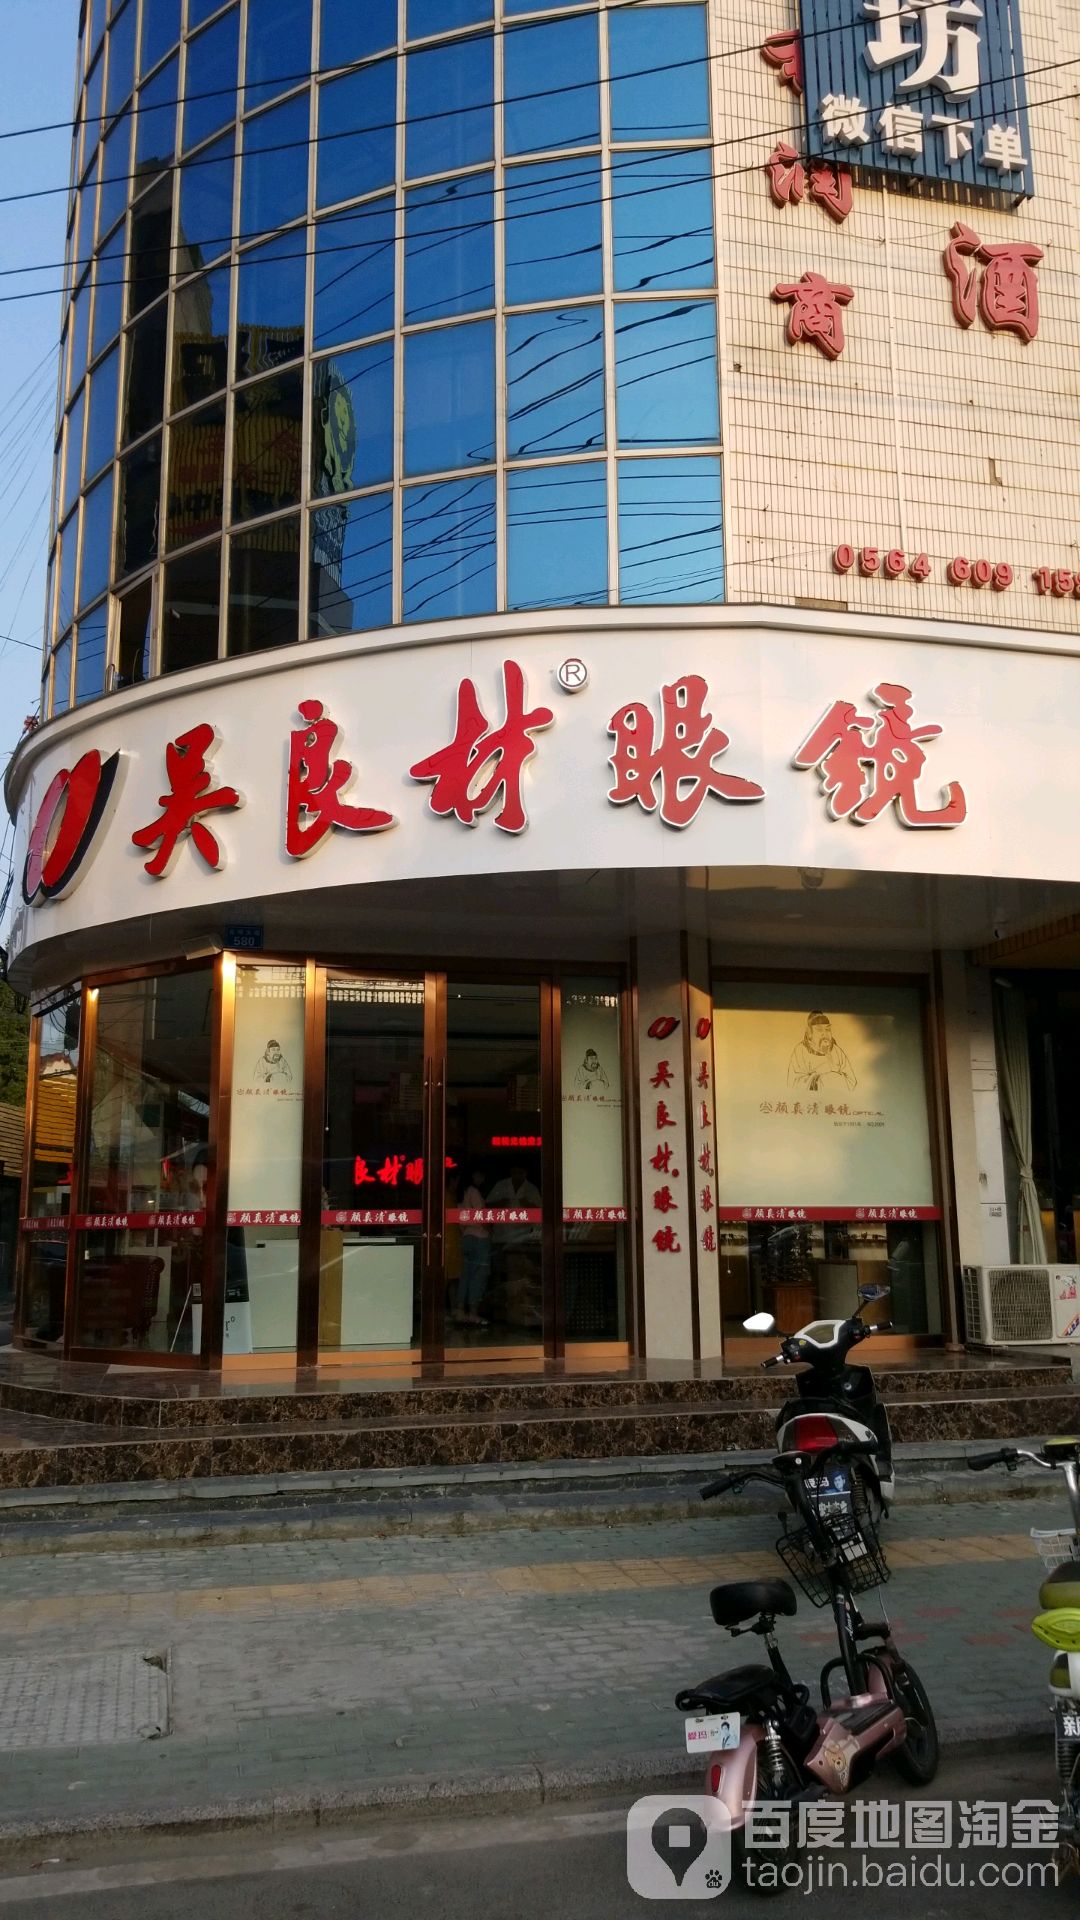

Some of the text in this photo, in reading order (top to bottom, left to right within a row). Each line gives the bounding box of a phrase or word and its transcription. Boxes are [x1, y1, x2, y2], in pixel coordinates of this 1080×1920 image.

[822, 93, 1029, 177] 微信下单
[832, 543, 1080, 599] 0564 609 15
[131, 659, 968, 878] 吴良材眼镜
[233, 936, 255, 946] 580
